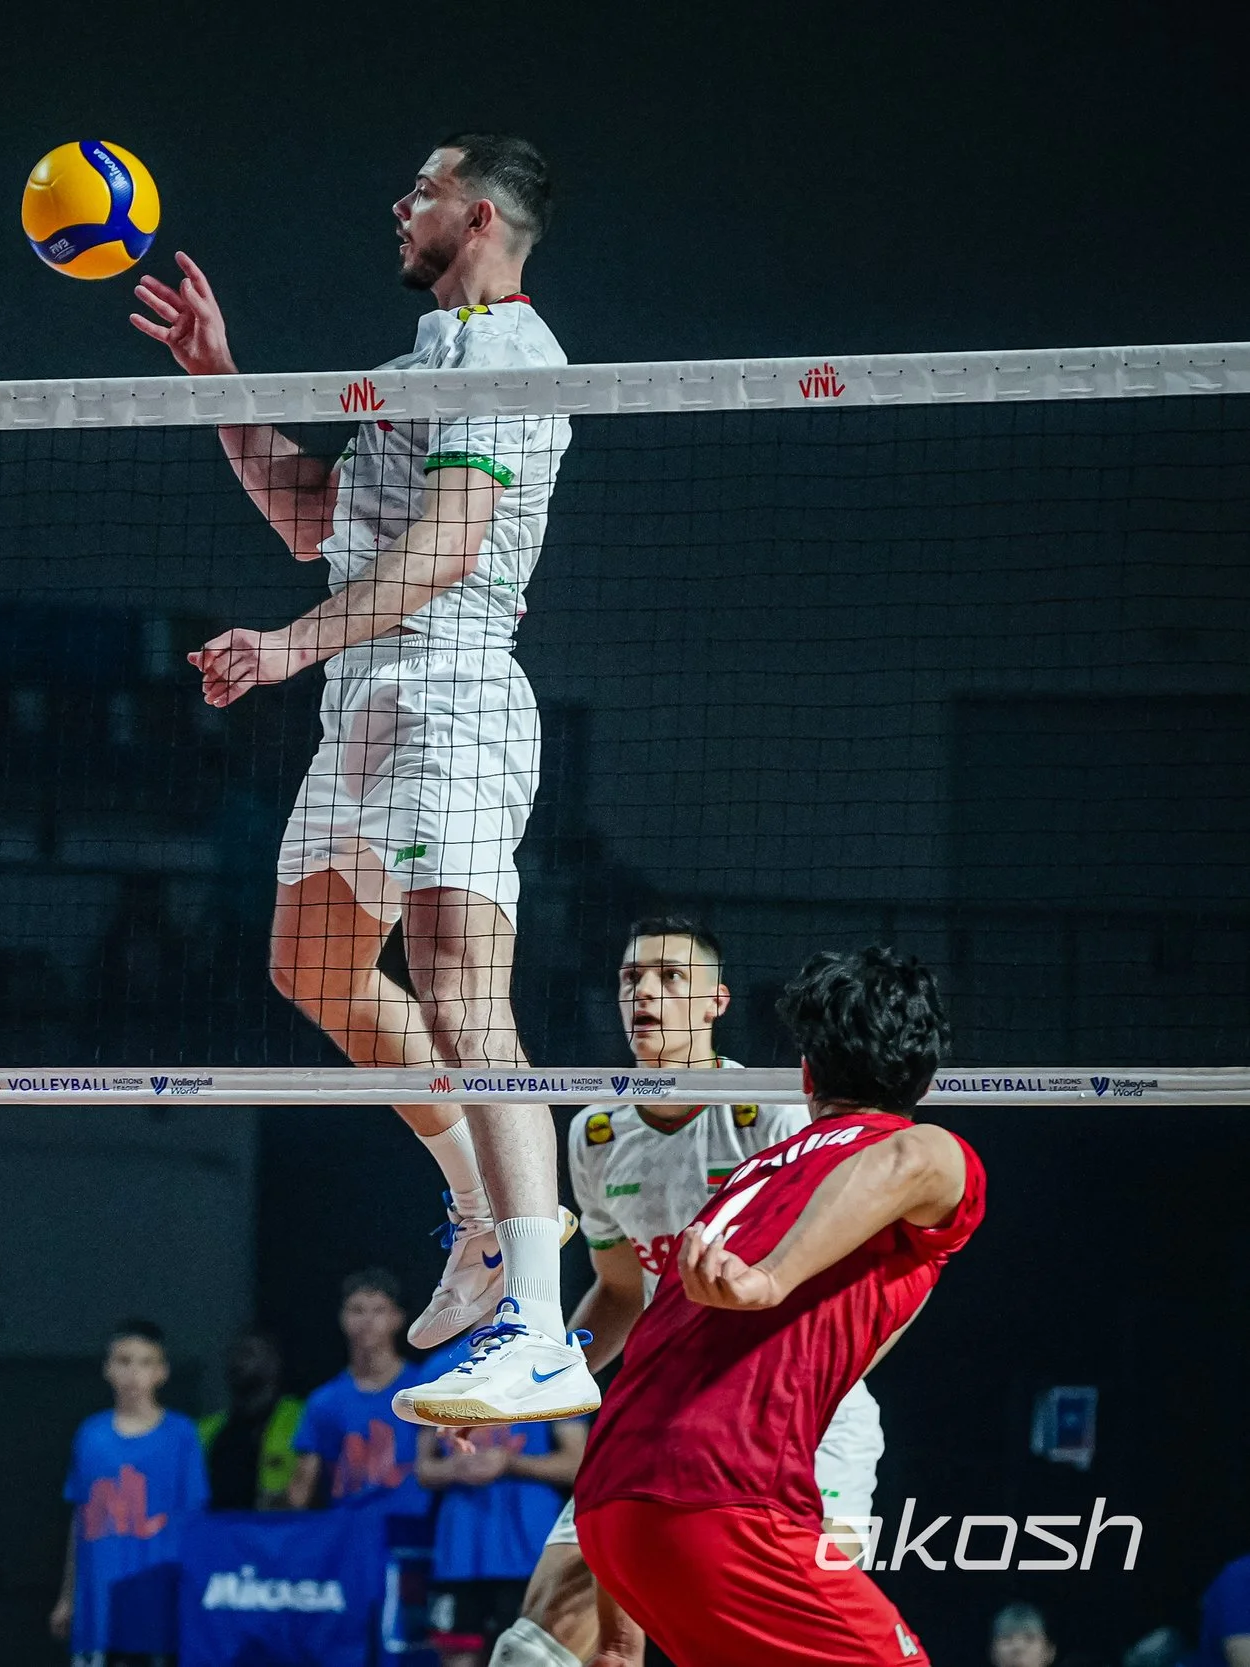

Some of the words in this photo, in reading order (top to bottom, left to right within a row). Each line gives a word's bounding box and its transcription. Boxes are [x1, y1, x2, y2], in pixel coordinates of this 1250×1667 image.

[799, 362, 846, 400] VNL
[339, 377, 385, 413] VNL
[8, 1078, 110, 1091] VOLLEYBALL
[171, 1077, 213, 1088] Volleyball
[463, 1078, 568, 1091] VOLLEYBALL
[632, 1078, 676, 1088] Volleyball
[935, 1078, 1047, 1092] VOLLEYBALL
[1112, 1079, 1158, 1089] Volleyball
[171, 1087, 199, 1095] World
[632, 1087, 662, 1095] World
[1112, 1088, 1144, 1096] World
